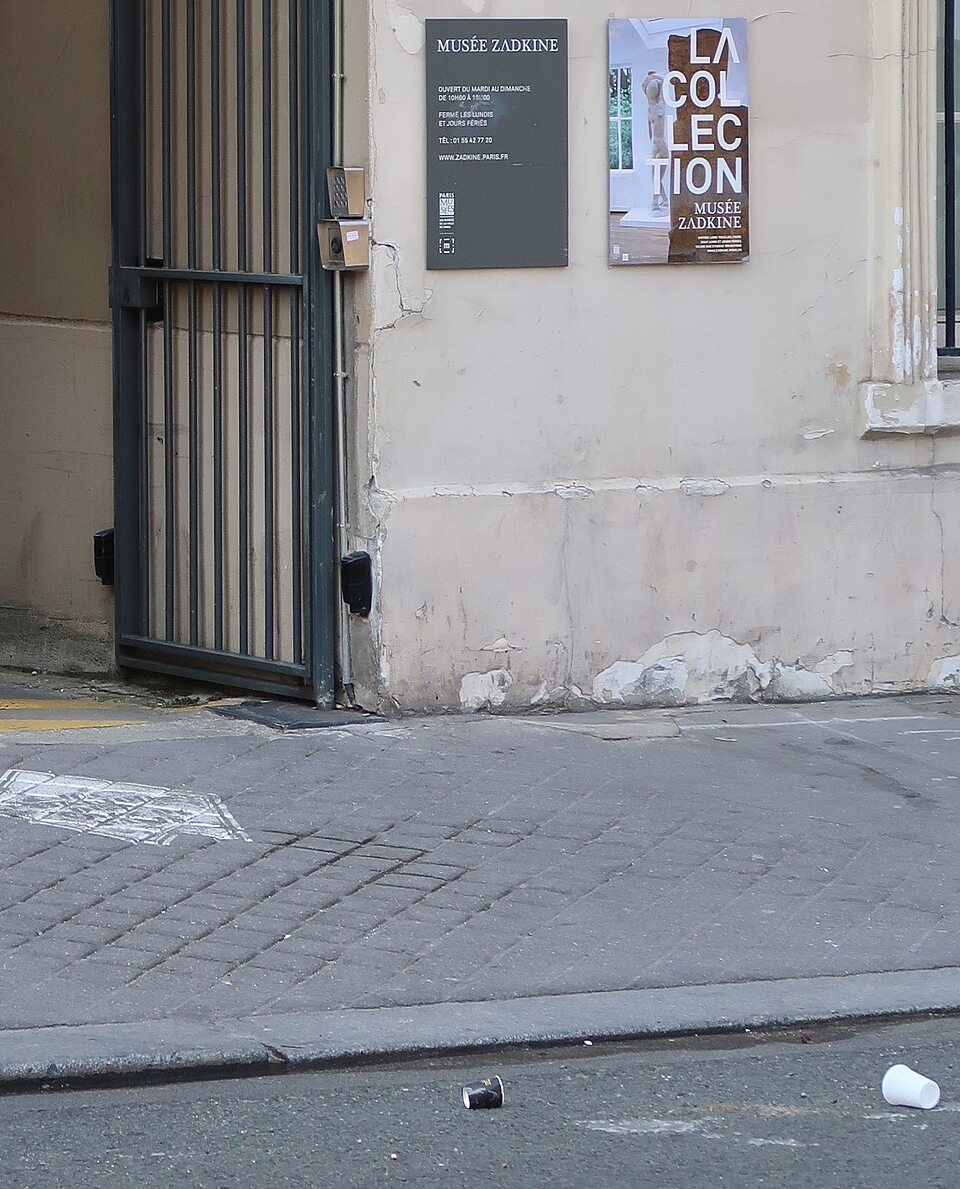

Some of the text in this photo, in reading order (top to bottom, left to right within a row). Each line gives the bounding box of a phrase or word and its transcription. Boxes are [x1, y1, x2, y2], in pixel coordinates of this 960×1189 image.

[437, 36, 559, 53] MUSÉE ZADKINE
[690, 27, 740, 64] LA
[466, 93, 471, 101] À
[663, 70, 741, 108] COL
[666, 113, 742, 151] LEC
[438, 153, 509, 161] WWW.ZADKINE.PARIS.FR
[646, 157, 742, 195] TION
[694, 198, 742, 215] MUSÉE
[678, 216, 742, 230] ZADKINE
